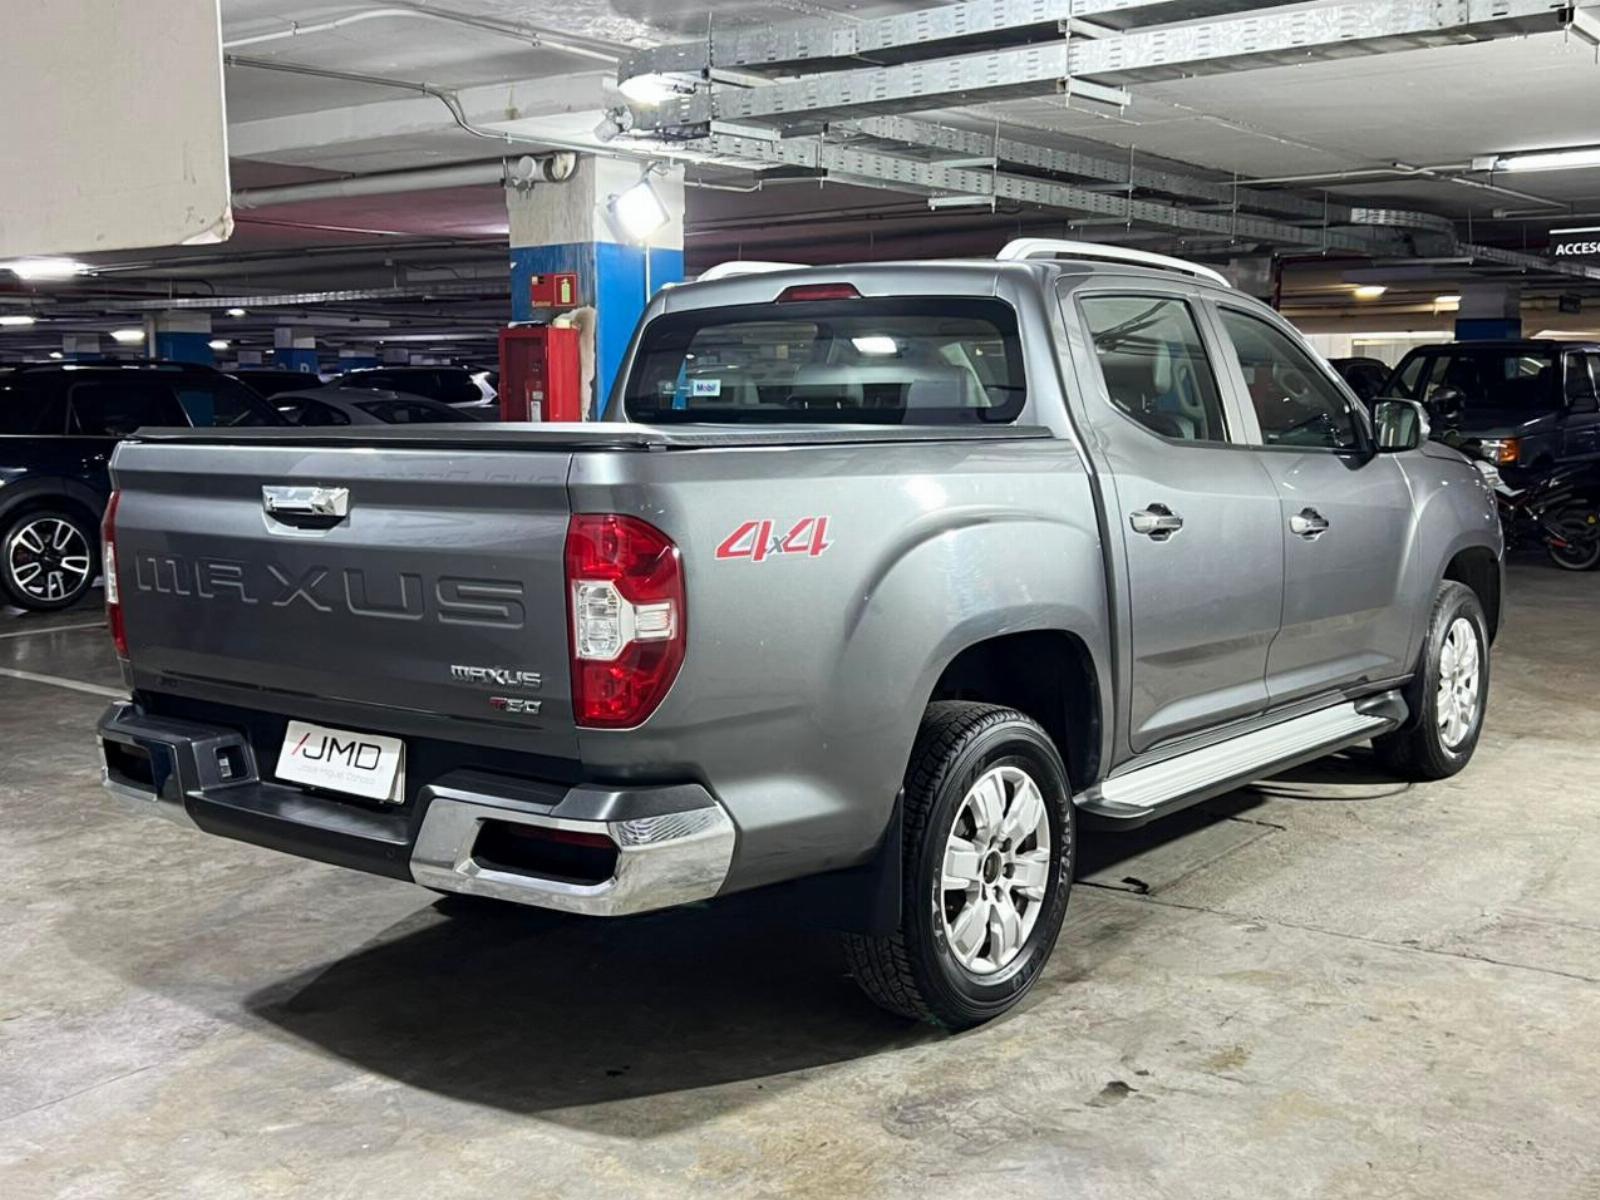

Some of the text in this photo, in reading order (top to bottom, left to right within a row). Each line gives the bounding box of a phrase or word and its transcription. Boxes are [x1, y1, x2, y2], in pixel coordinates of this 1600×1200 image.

[715, 515, 832, 561] 4x4
[136, 551, 527, 629] MAXUS
[450, 664, 541, 687] MAXUS
